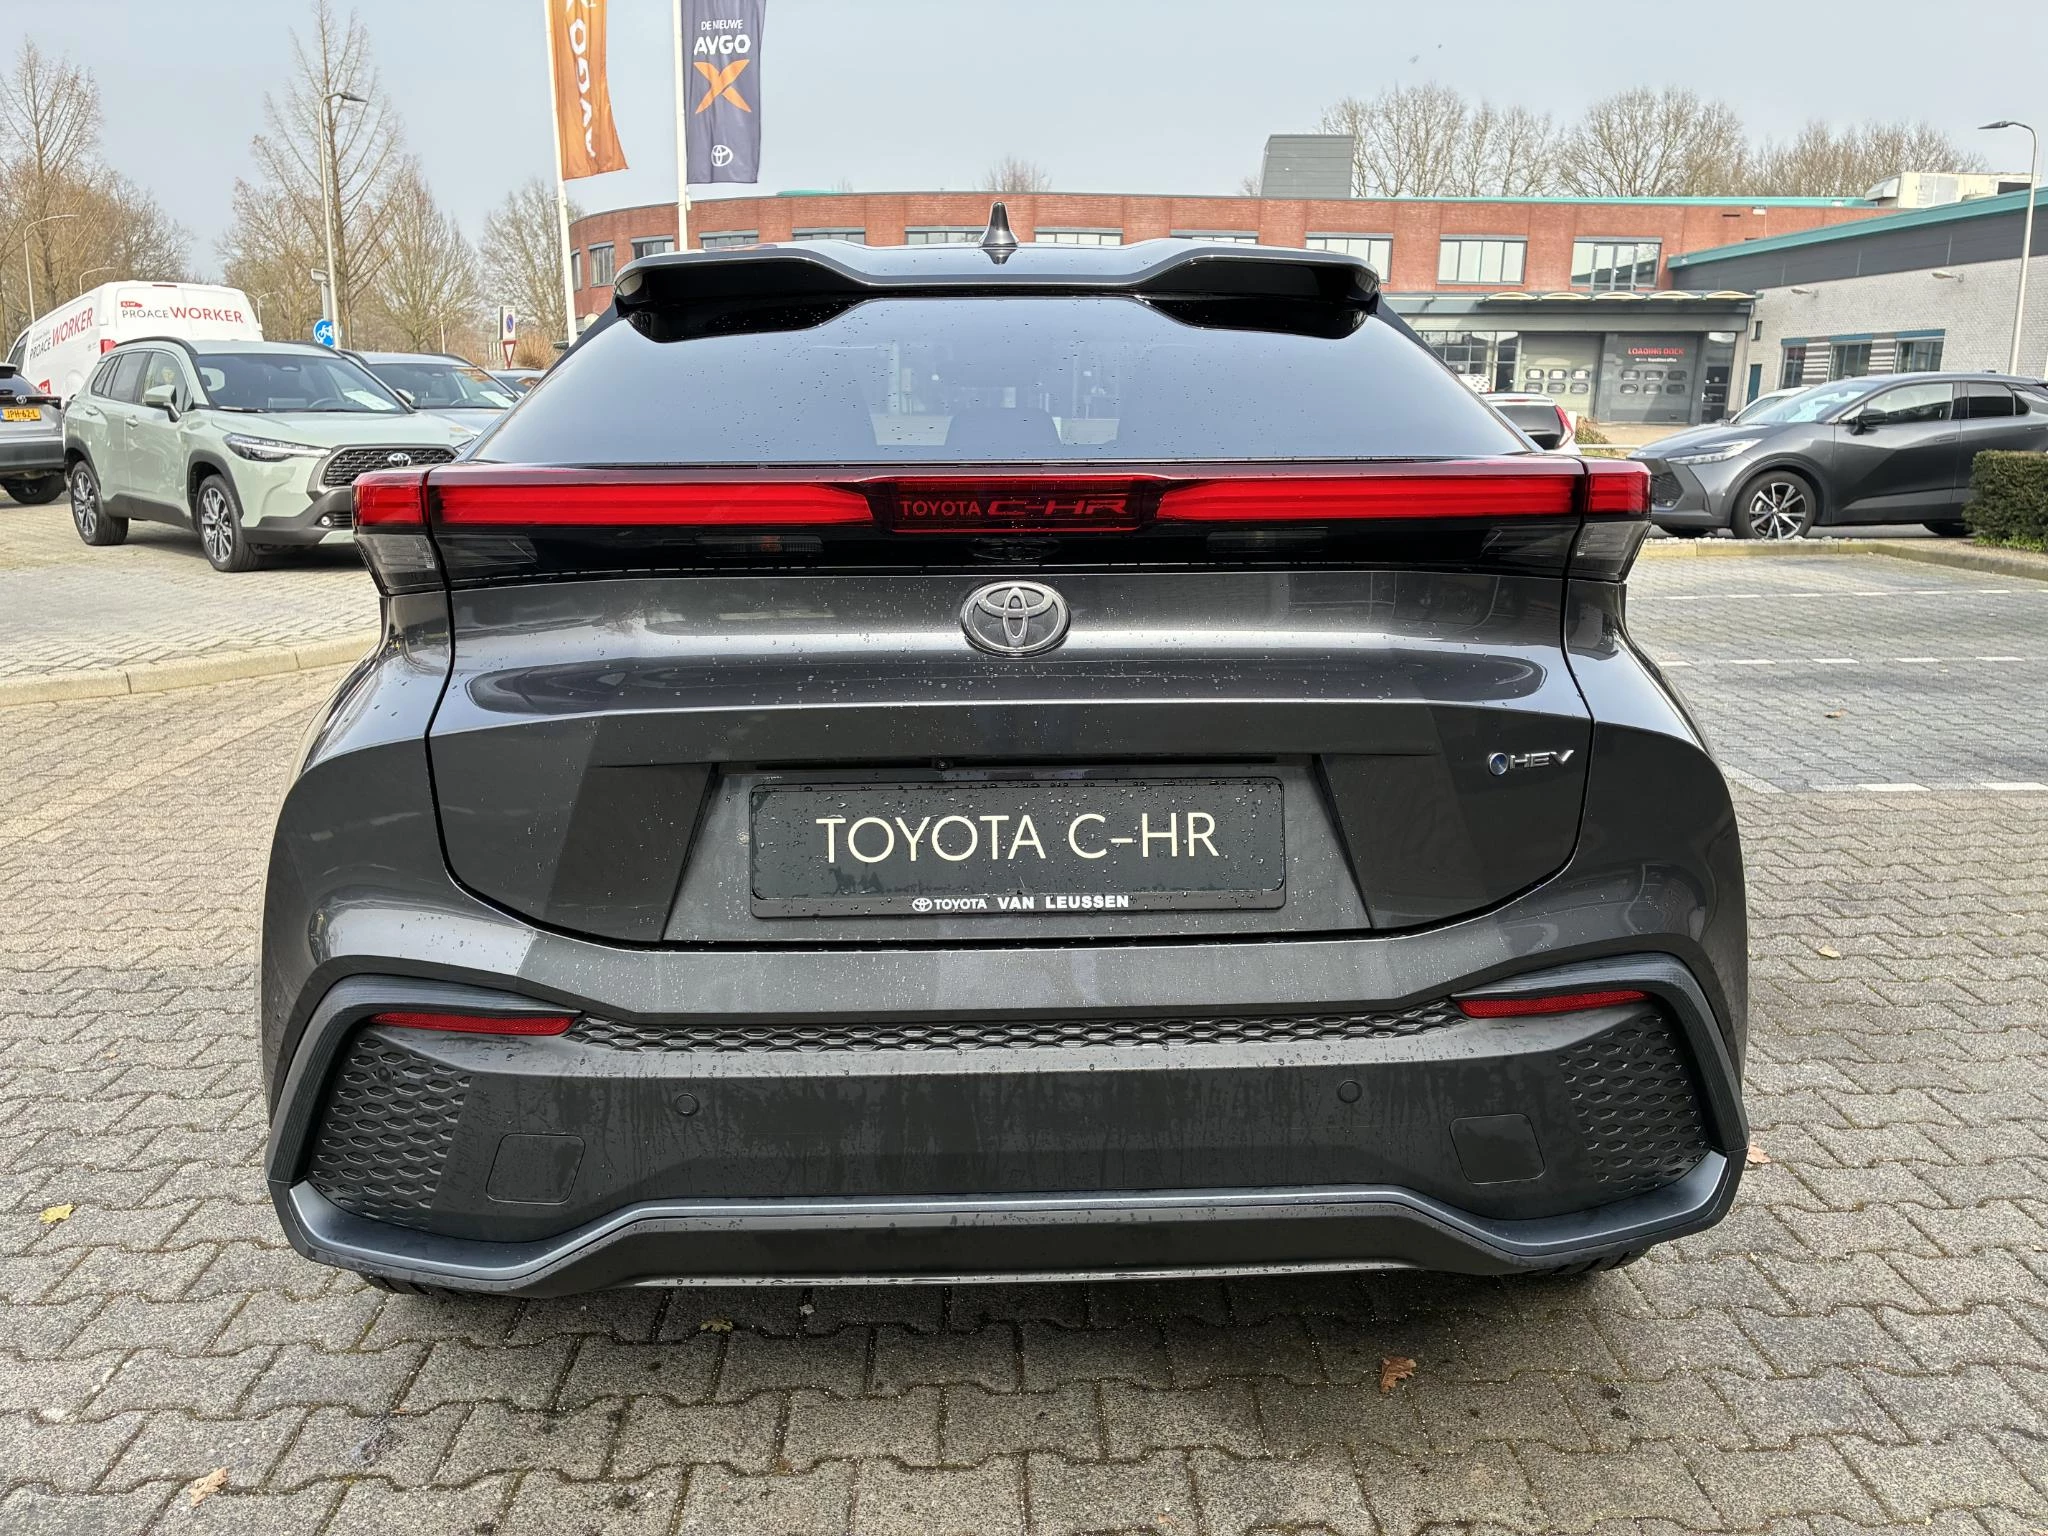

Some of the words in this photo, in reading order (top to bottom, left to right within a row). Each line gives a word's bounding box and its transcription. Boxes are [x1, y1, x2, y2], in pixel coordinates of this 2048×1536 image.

[701, 21, 712, 31] DE
[712, 19, 744, 30] NIEUWE
[693, 34, 752, 56] AYGO
[121, 309, 169, 319] PROACE
[169, 306, 245, 324] WORKER
[29, 337, 52, 361] PROACE
[51, 307, 94, 347] WORKER
[1628, 347, 1662, 356] LOADING
[1663, 347, 1684, 356] DOCK
[900, 501, 982, 516] TOYOTA
[988, 500, 1127, 516] C-HR
[1509, 749, 1575, 770] HEV
[815, 814, 1047, 864] TOYOTA
[1068, 812, 1220, 860] C-HR
[933, 899, 988, 911] TOYOTA
[997, 896, 1035, 911] VAN
[1045, 895, 1130, 910] LEUSSEN
